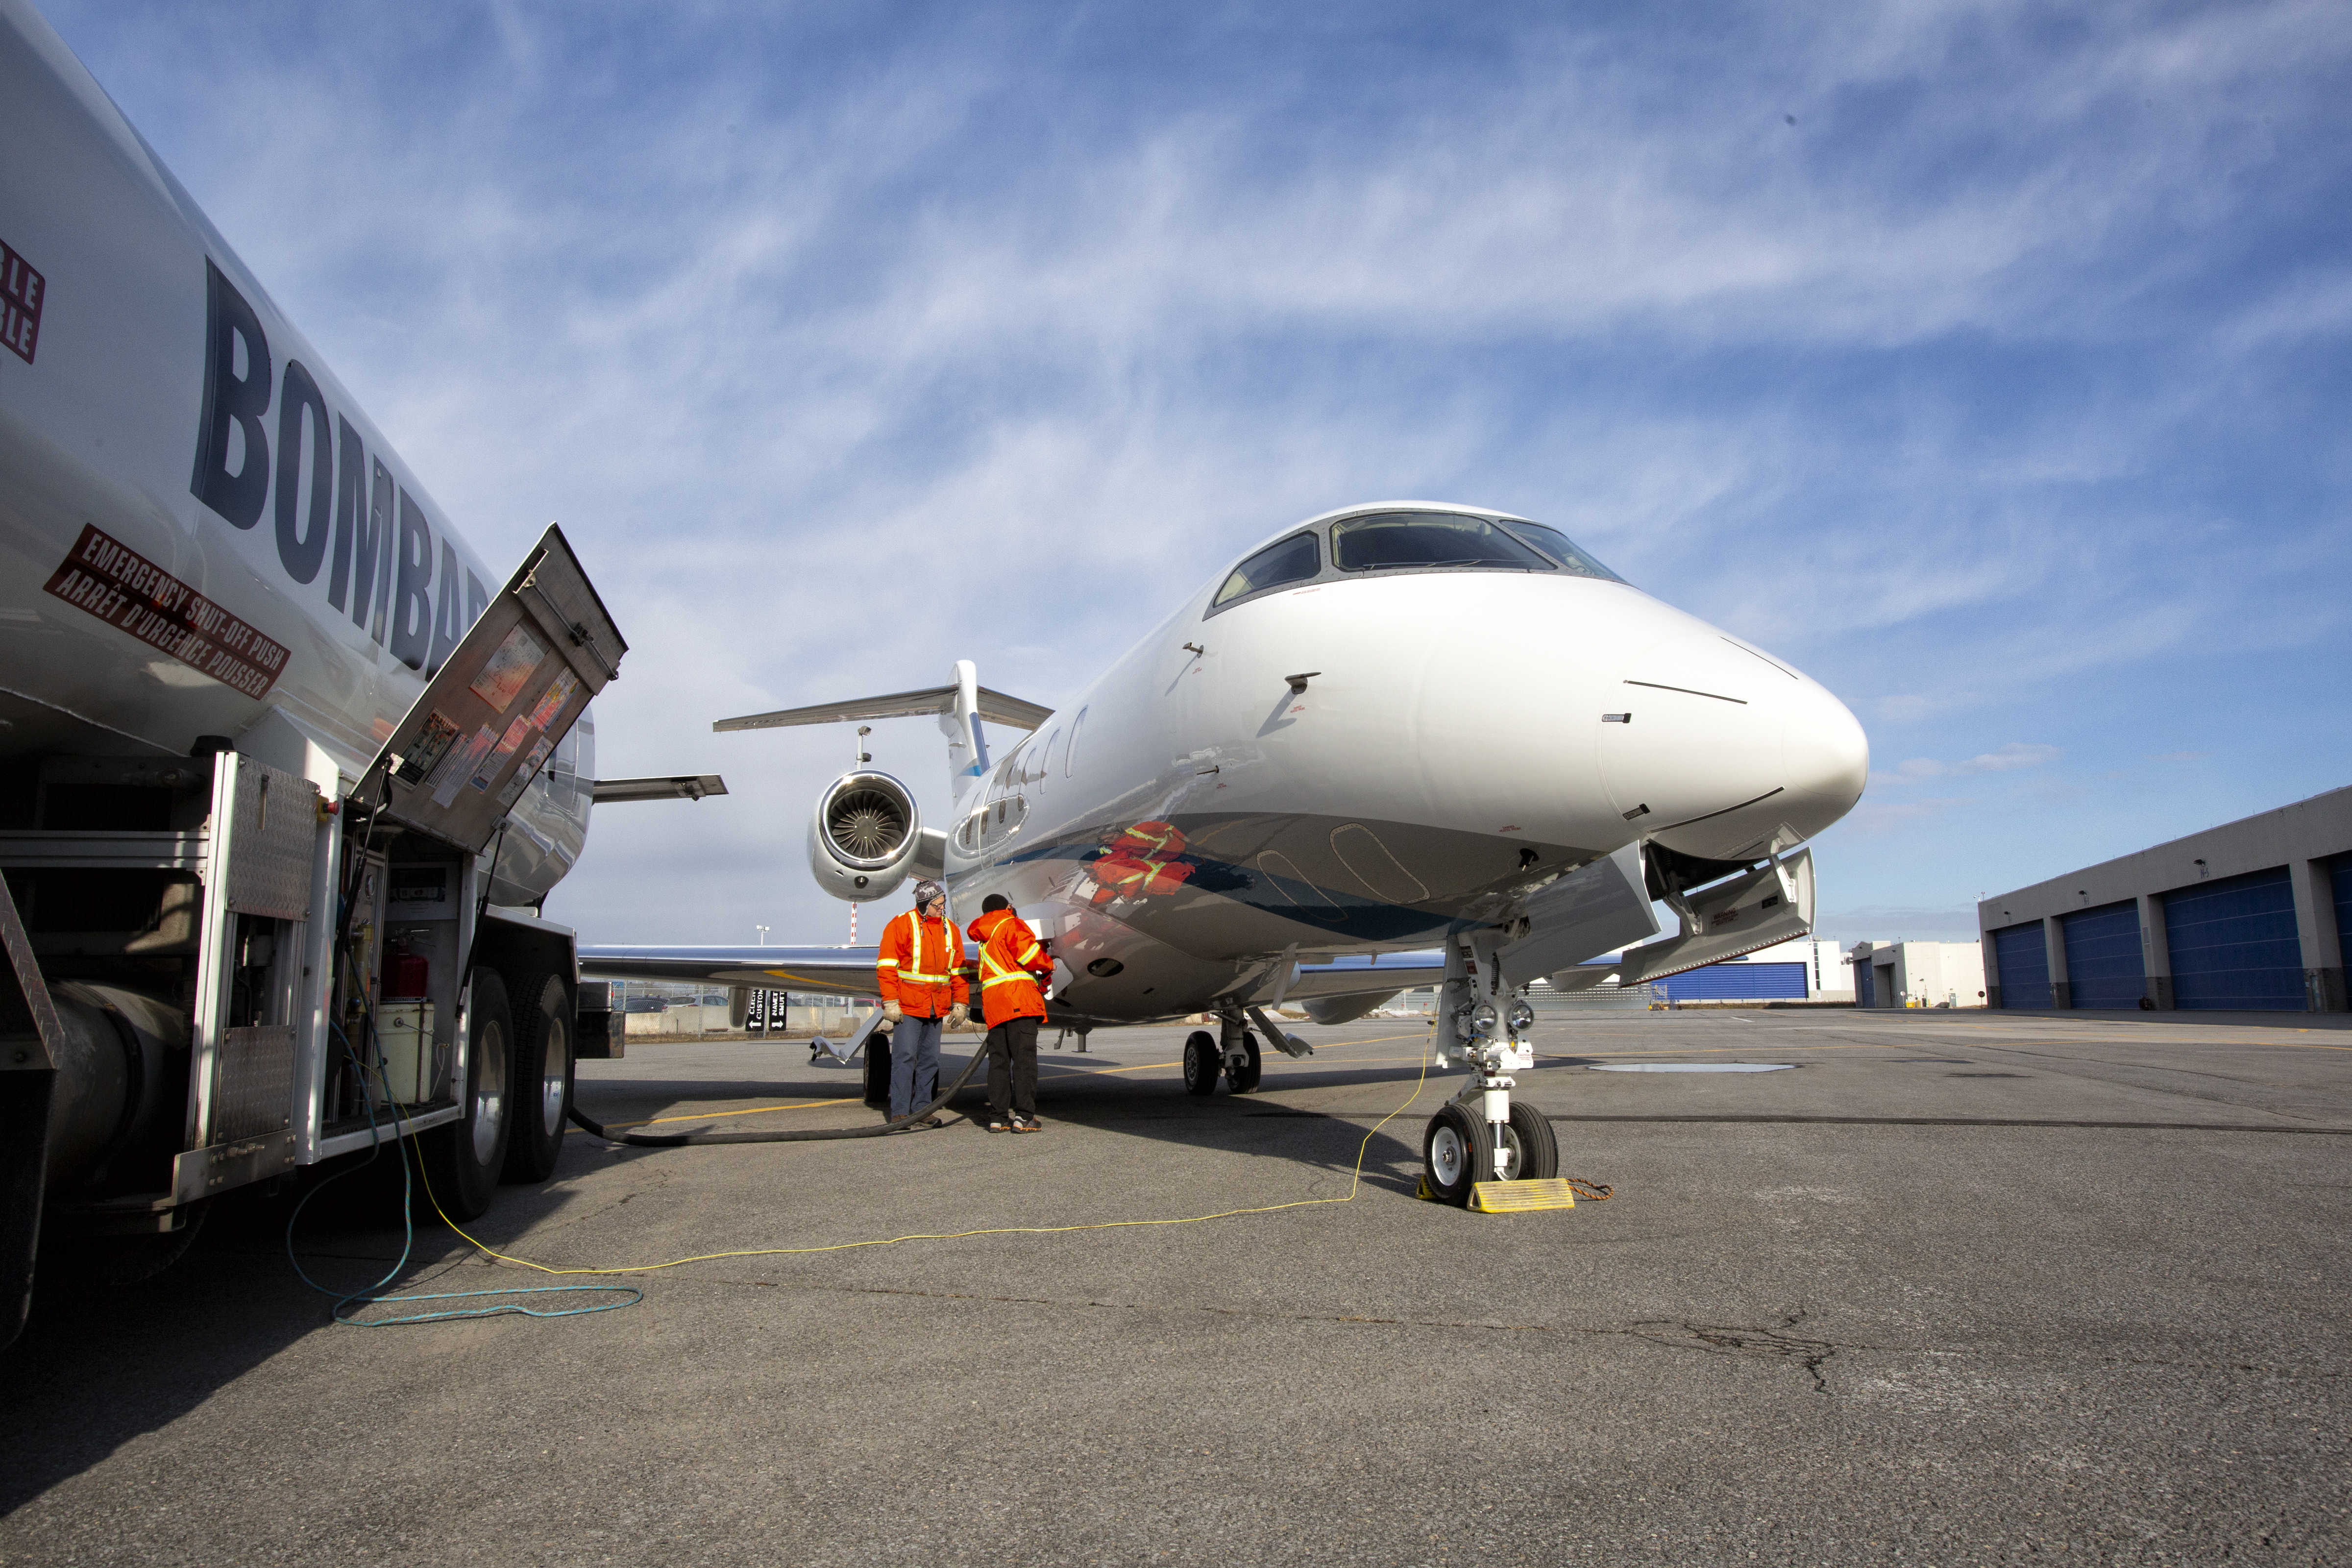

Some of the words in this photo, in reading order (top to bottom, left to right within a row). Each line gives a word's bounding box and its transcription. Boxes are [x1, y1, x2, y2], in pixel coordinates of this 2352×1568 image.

[55, 569, 128, 618] ARRÊT
[121, 604, 212, 665] D'URGENCE
[205, 650, 268, 696] POUSSER
[82, 533, 189, 612] EMERGENCY
[185, 597, 252, 650] SHUT-OFF
[247, 636, 285, 670] PUSH
[1713, 908, 1736, 920] WARNING
